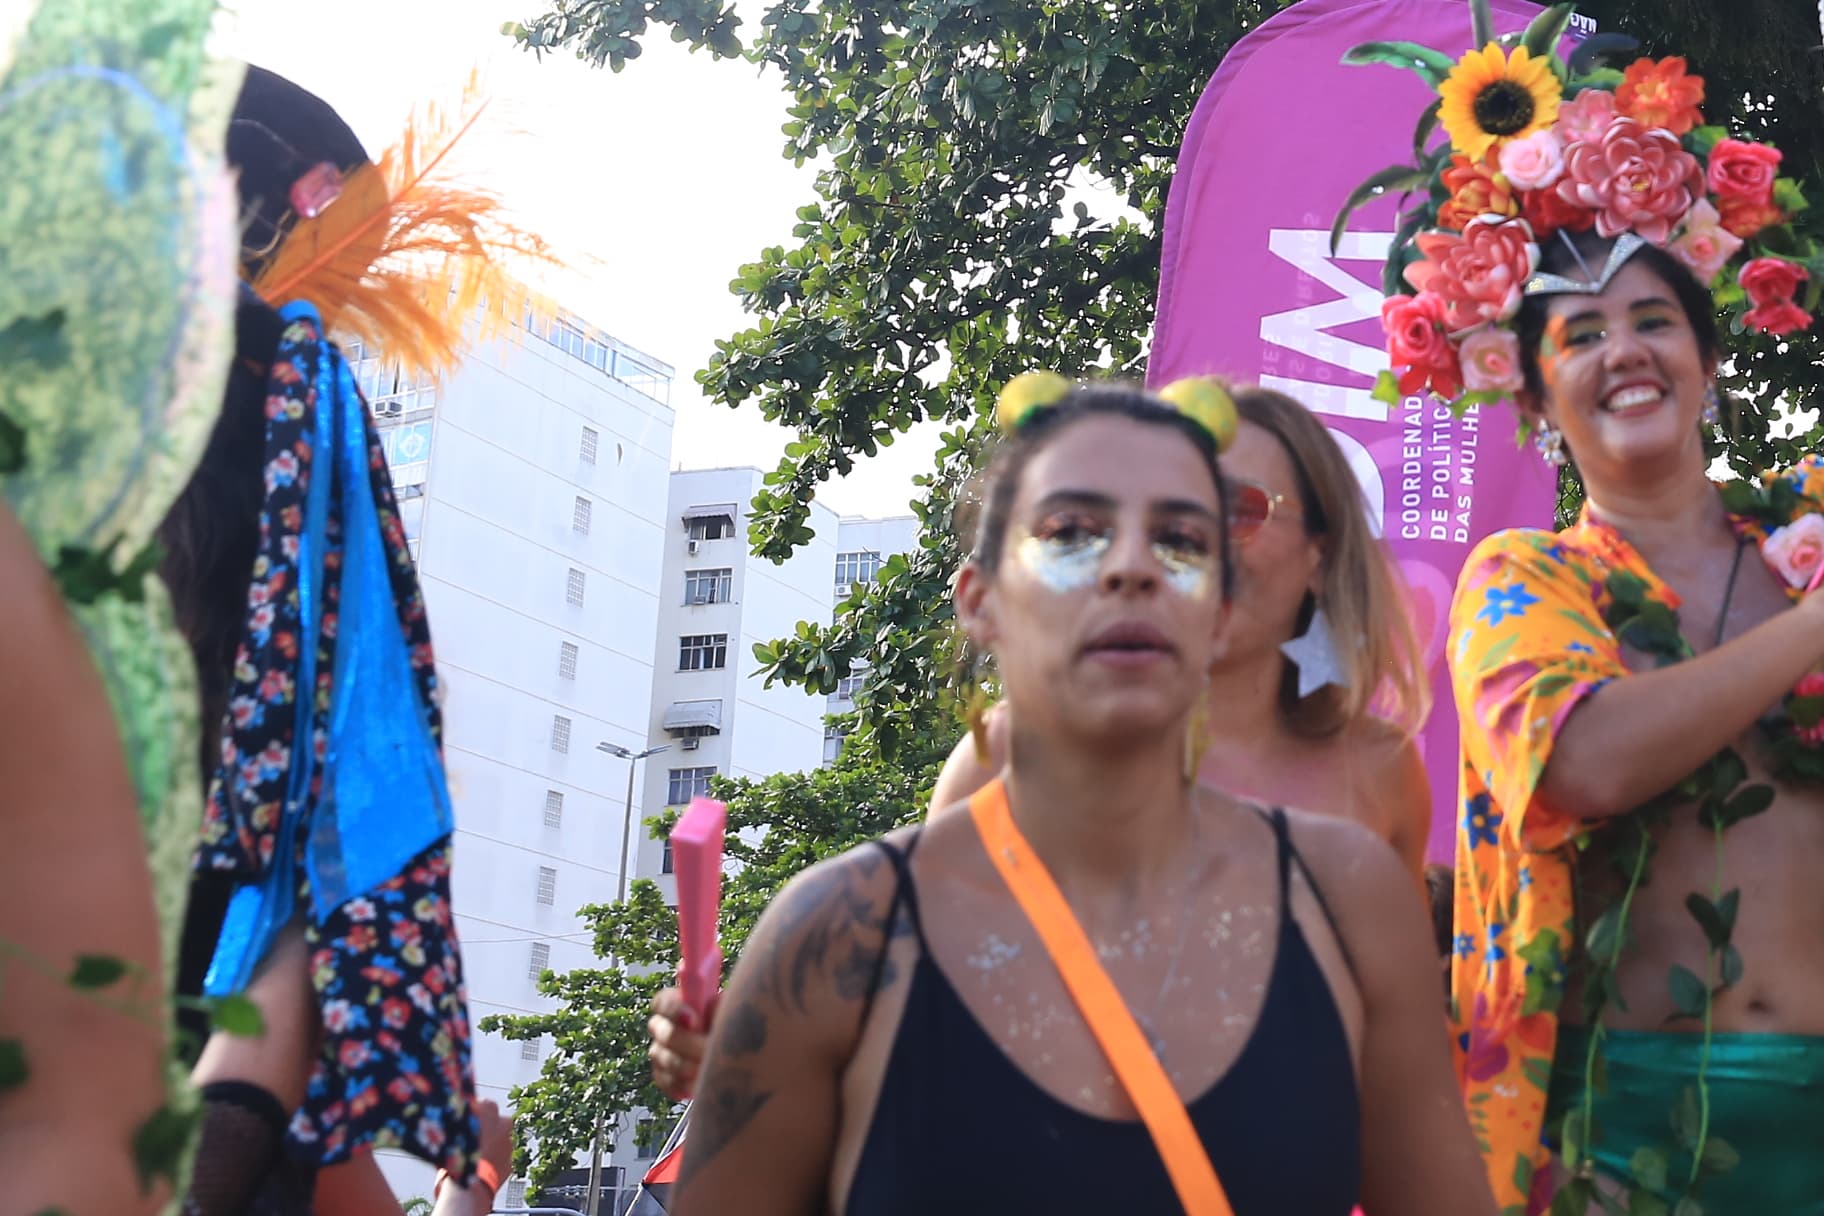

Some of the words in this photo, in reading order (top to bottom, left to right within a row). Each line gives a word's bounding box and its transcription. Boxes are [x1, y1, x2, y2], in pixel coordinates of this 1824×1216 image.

[1402, 396, 1422, 539] COORDENAD
[1427, 407, 1452, 499] POLÍTIC
[1459, 402, 1480, 485] MULHE
[1431, 509, 1449, 540] DE
[1454, 495, 1472, 543] DAS
